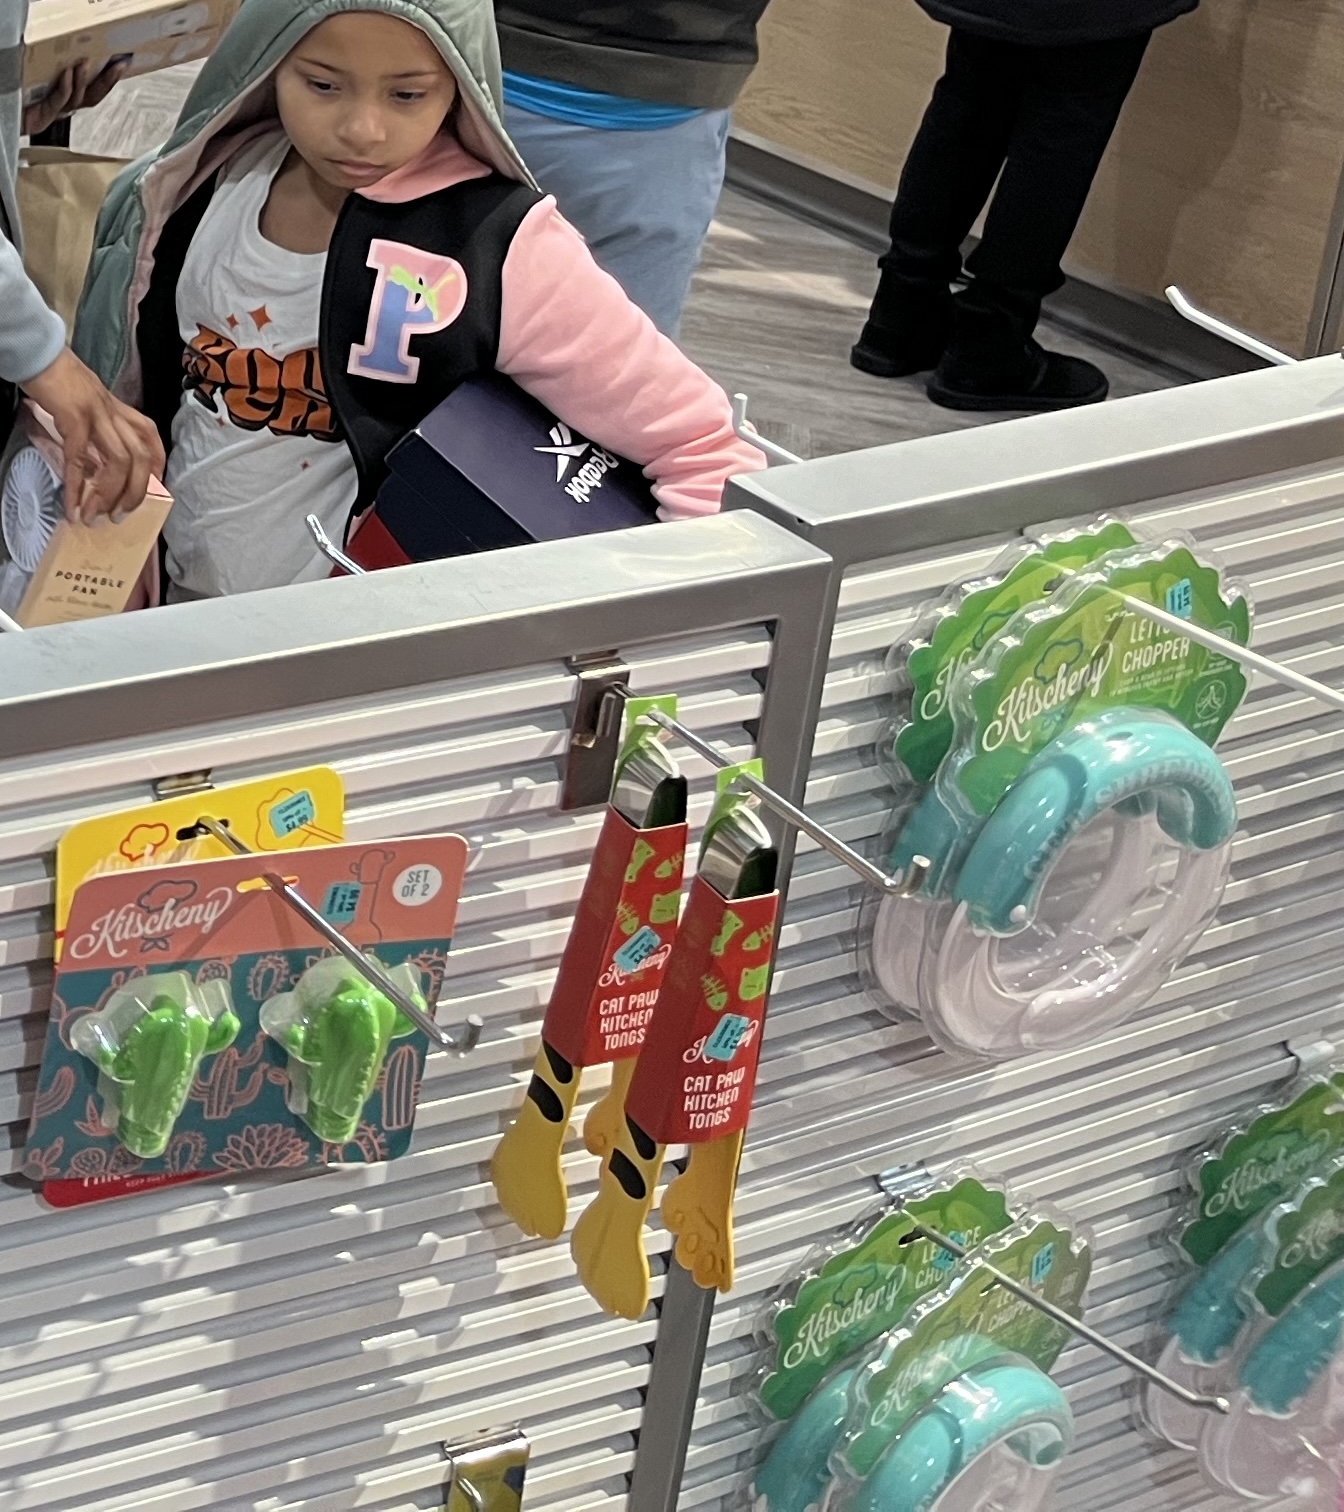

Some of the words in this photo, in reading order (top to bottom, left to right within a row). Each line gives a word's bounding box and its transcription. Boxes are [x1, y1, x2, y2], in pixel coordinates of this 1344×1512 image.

[563, 445, 621, 504] Reebok
[55, 570, 125, 589] PORTABLE
[72, 584, 98, 596] FAN
[1121, 637, 1191, 675] CHOPPER
[980, 640, 1114, 753] Kitscheny
[406, 869, 430, 884] SET
[401, 885, 418, 898] OF
[421, 883, 430, 897] 2
[70, 886, 233, 960] Kitscheny
[599, 996, 627, 1016] CAT
[627, 988, 660, 1010] PAW
[599, 1008, 654, 1034] KITCHEN
[604, 1028, 647, 1051] TONGS
[683, 1074, 713, 1093] CAT
[715, 1066, 747, 1090] PAW
[683, 1086, 740, 1112] KITCHEN
[688, 1106, 732, 1130] TONGS
[783, 1264, 907, 1369] Kitscheny
